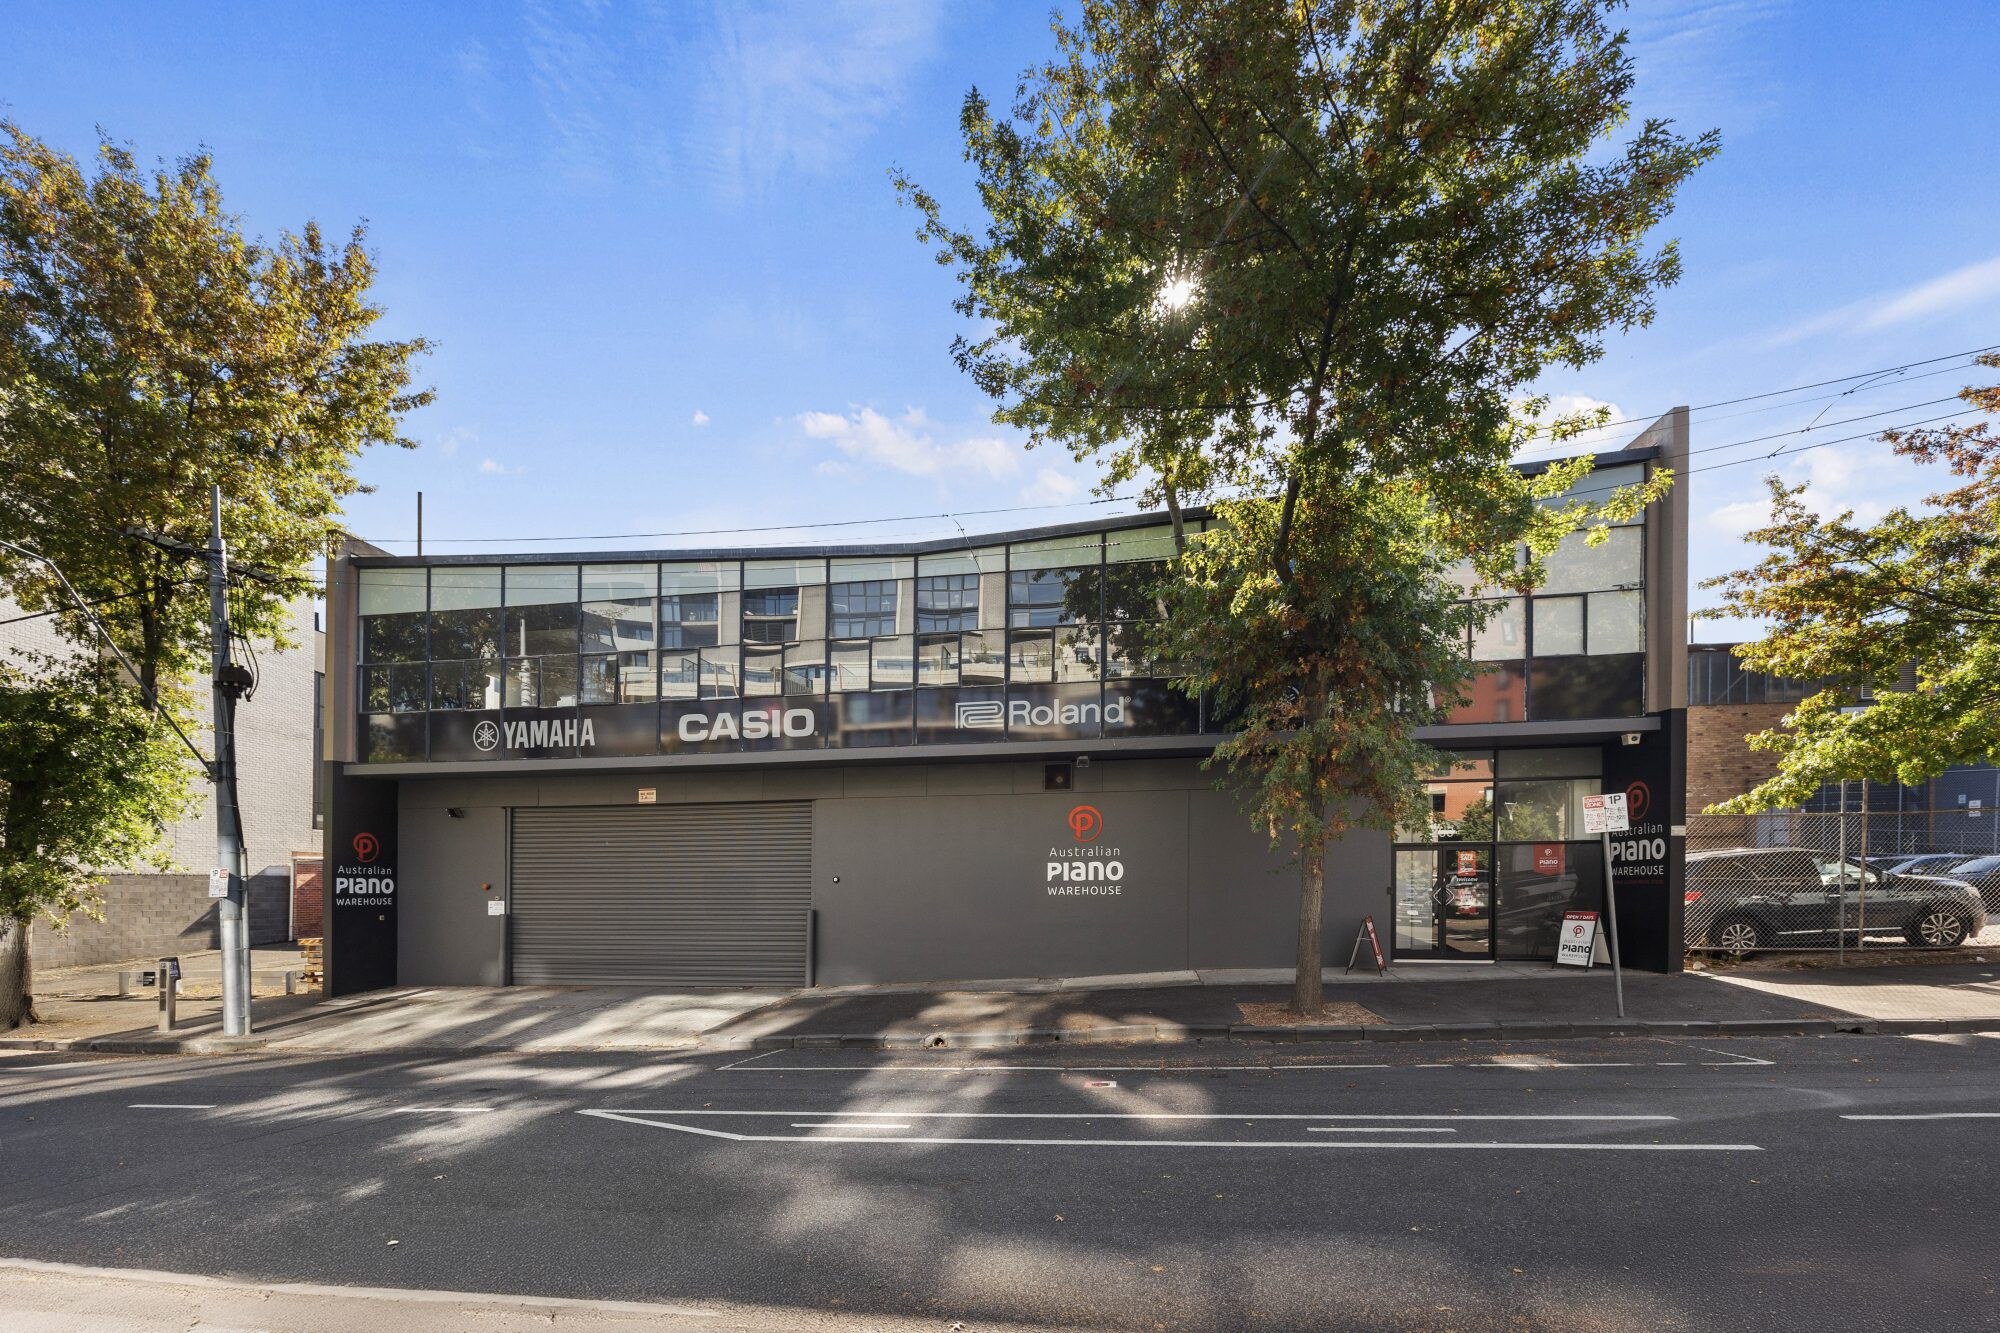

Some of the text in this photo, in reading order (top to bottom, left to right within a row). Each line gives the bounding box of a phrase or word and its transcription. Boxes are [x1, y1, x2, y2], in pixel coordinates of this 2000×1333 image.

[1008, 696, 1125, 727] Roland
[678, 708, 815, 742] CASIO
[503, 718, 596, 749] YAMAHA
[1608, 795, 1621, 804] 1P
[1049, 846, 1121, 857] Australian
[337, 865, 392, 875] Australian
[1611, 865, 1665, 876] WAREHOUSE
[1047, 885, 1122, 896] WAREHOUSE
[336, 897, 393, 906] WAREHOUSE
